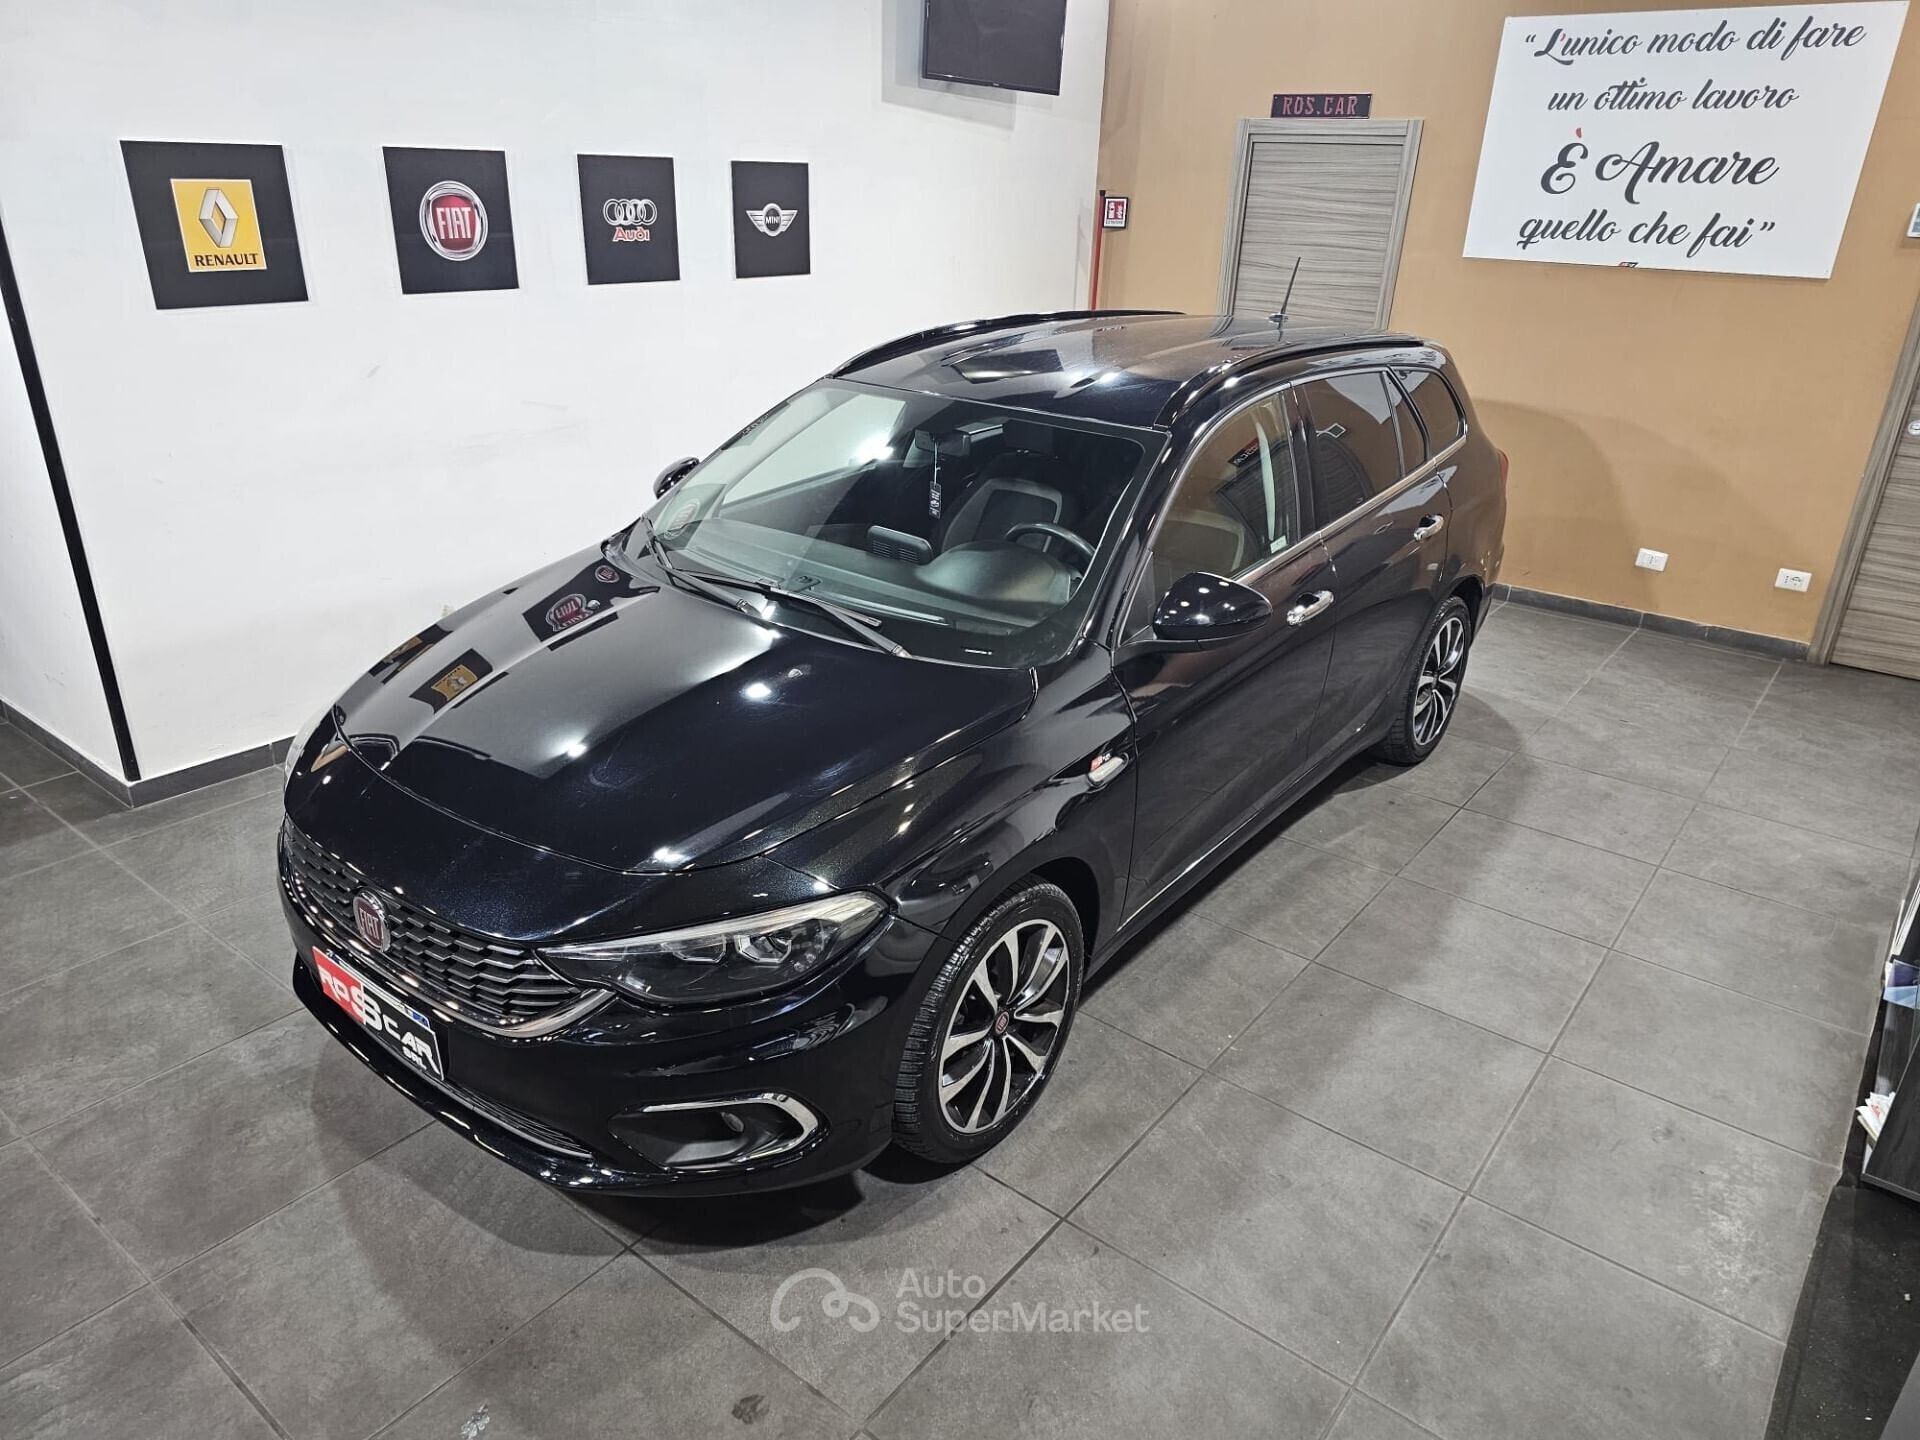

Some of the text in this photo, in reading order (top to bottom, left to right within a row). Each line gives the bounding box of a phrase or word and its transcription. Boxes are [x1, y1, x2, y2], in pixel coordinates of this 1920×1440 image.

[1647, 20, 1740, 53] modo
[1747, 17, 1784, 50] di
[1780, 16, 1867, 61] fare
[1282, 96, 1358, 115] ROS.CAR
[1548, 77, 1801, 111] un ottimo lavoro
[1540, 127, 1779, 205] È Amare
[436, 206, 472, 240] FIAT
[612, 226, 650, 242] Audi
[1517, 208, 1621, 250] quello
[1627, 211, 1690, 244] che
[194, 253, 258, 268] RENAULT
[359, 907, 379, 940] FIAT
